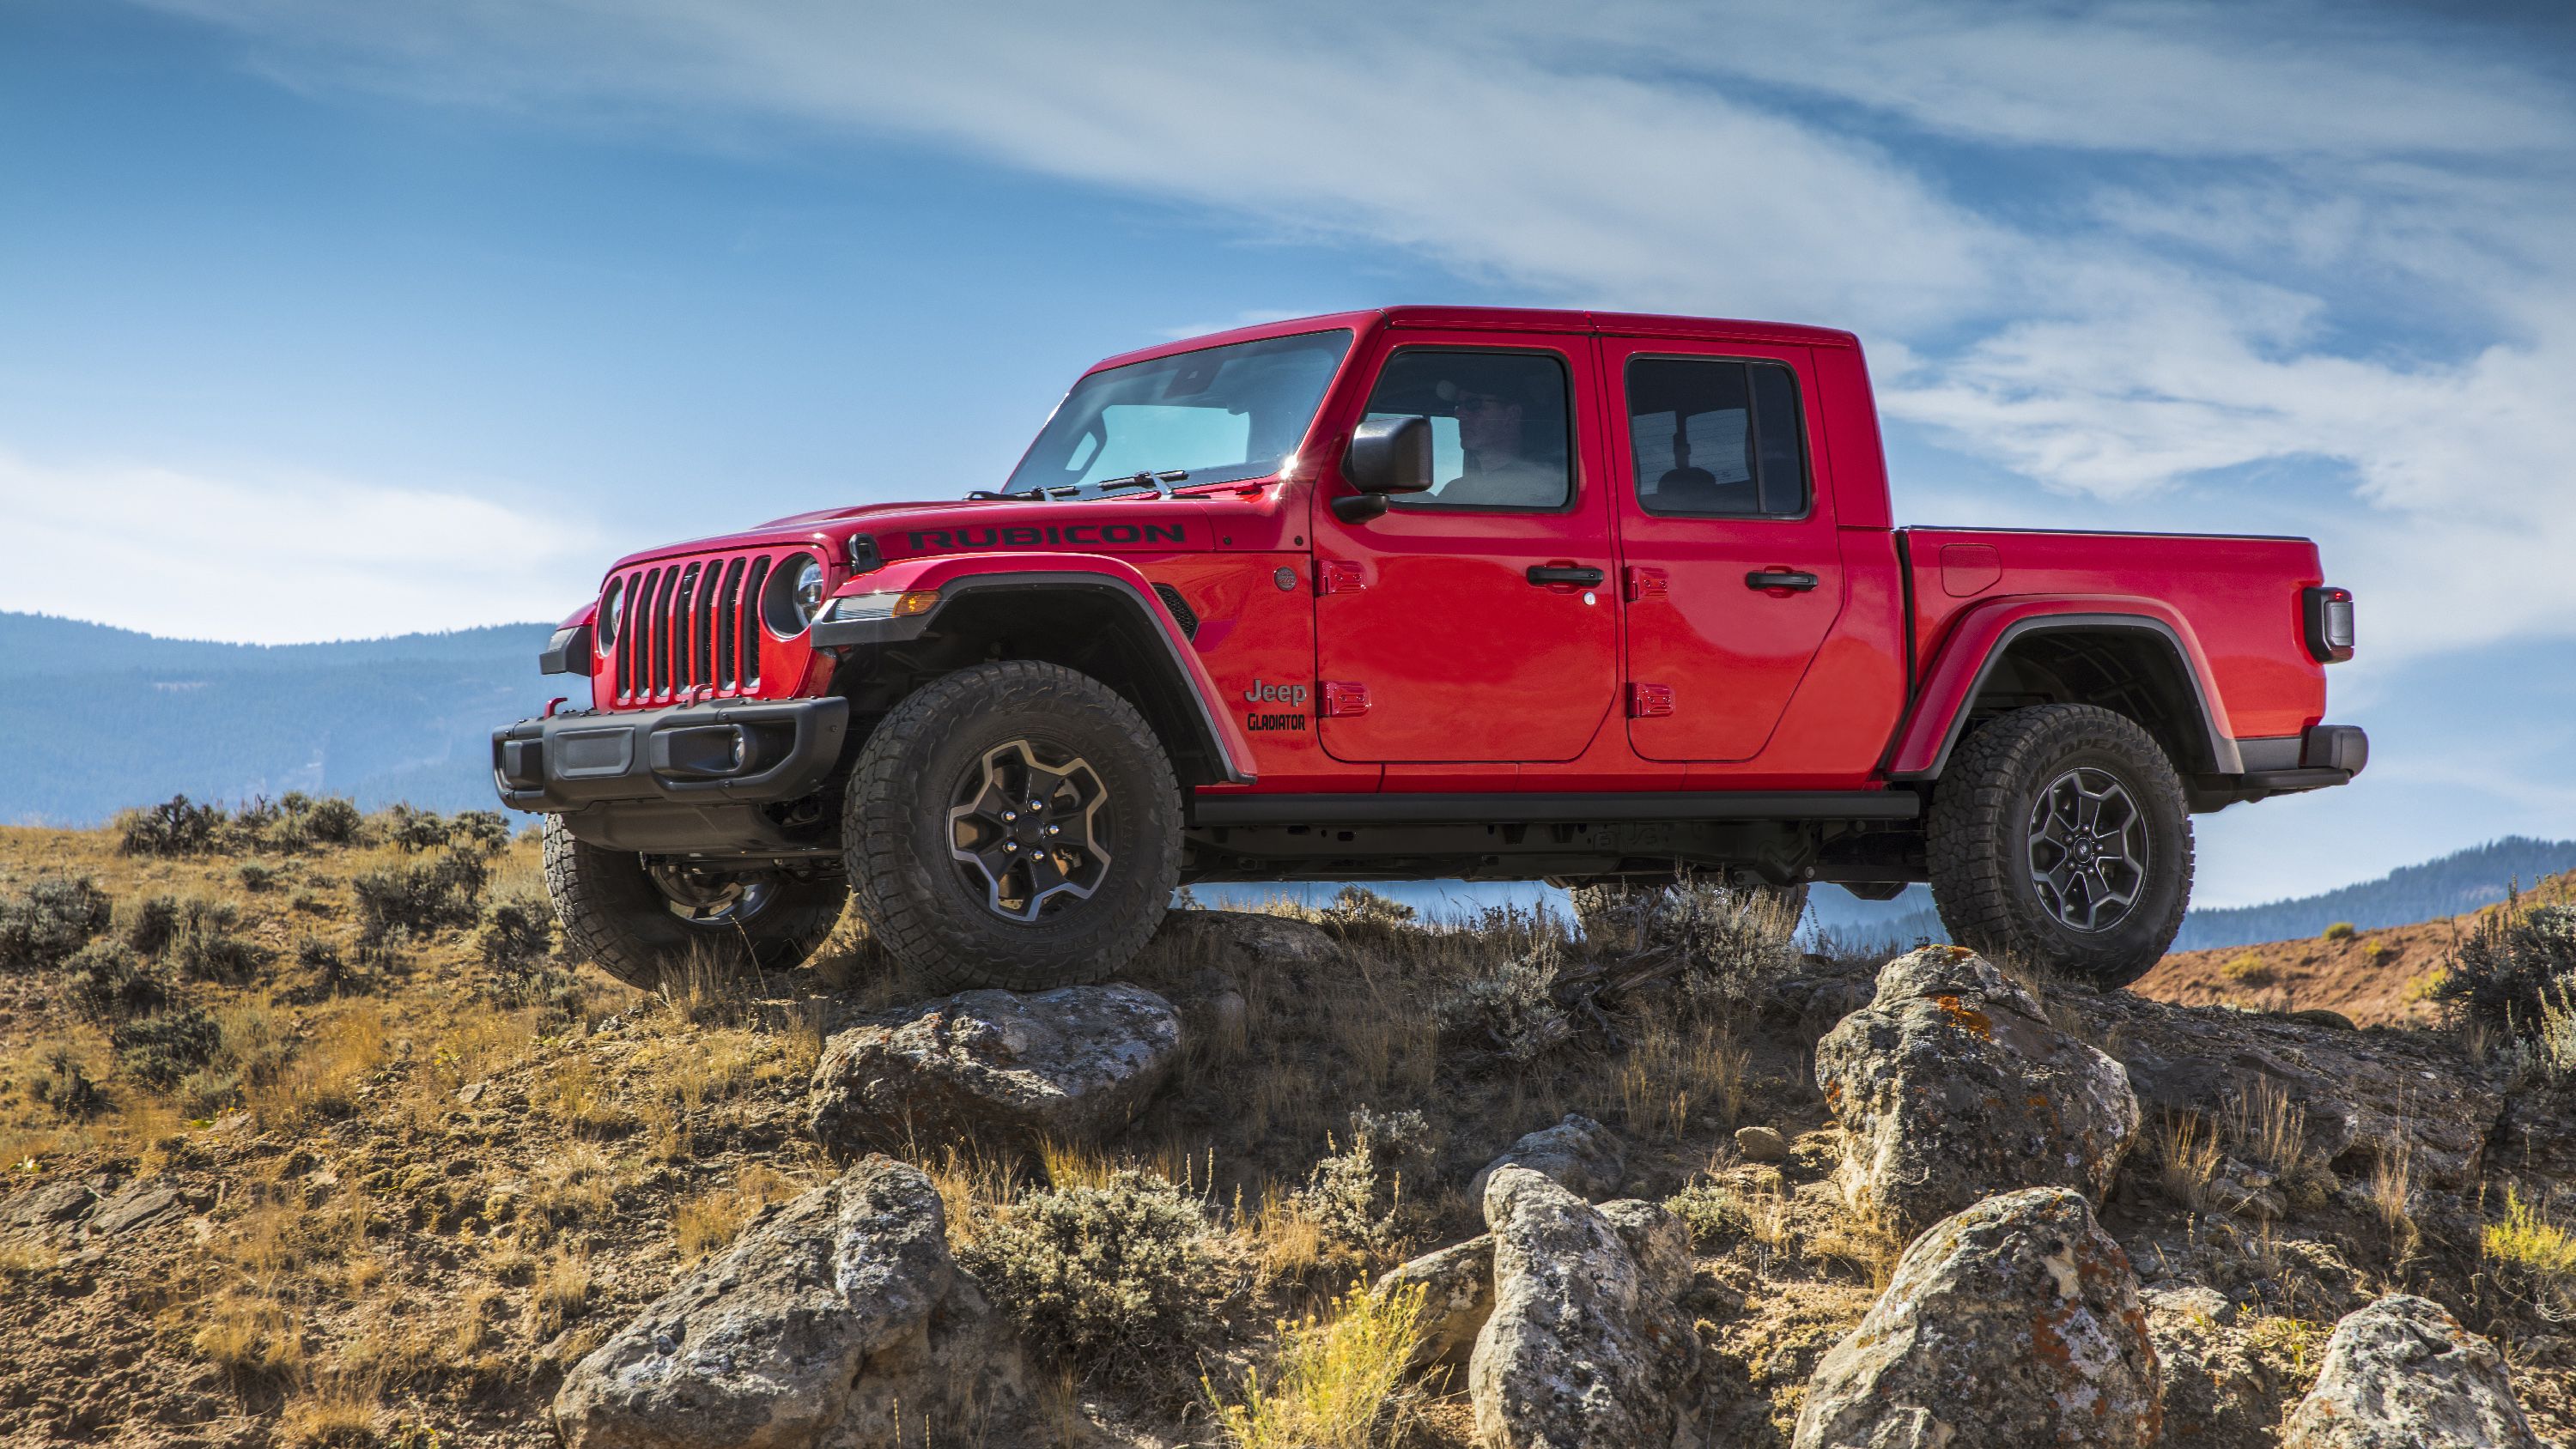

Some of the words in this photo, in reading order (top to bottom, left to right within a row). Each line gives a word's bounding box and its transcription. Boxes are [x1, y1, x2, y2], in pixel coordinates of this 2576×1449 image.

[908, 524, 1187, 550] RUBICON
[1245, 679, 1306, 706] Jeep
[1248, 713, 1305, 731] GLADIATOR
